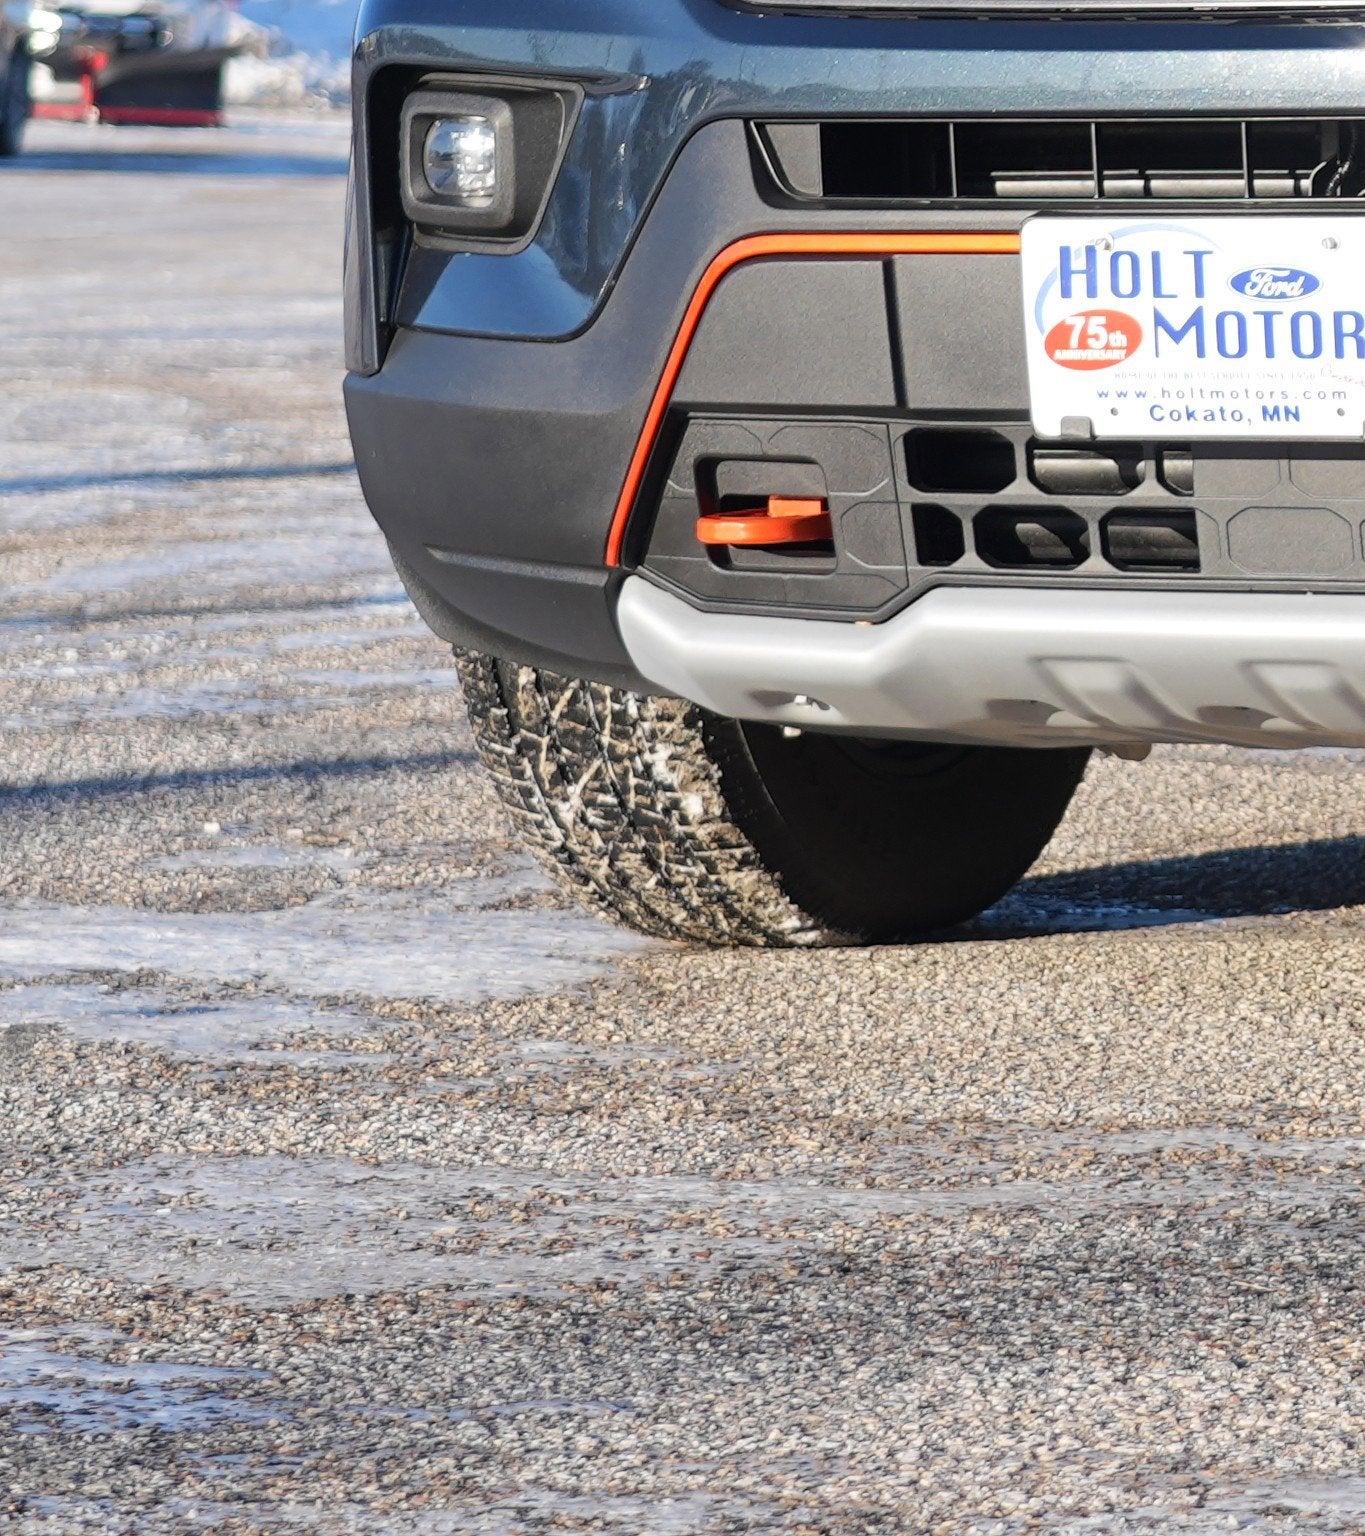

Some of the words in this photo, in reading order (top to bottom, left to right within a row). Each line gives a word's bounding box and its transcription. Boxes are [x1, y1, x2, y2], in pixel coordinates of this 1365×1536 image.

[1059, 245, 1213, 298] HOLT
[1243, 267, 1306, 299] Ford
[1065, 315, 1128, 350] 75th
[1096, 386, 1348, 401] www.holtmotors.com
[1149, 404, 1253, 426] Cokato,
[1262, 406, 1301, 423] MN
